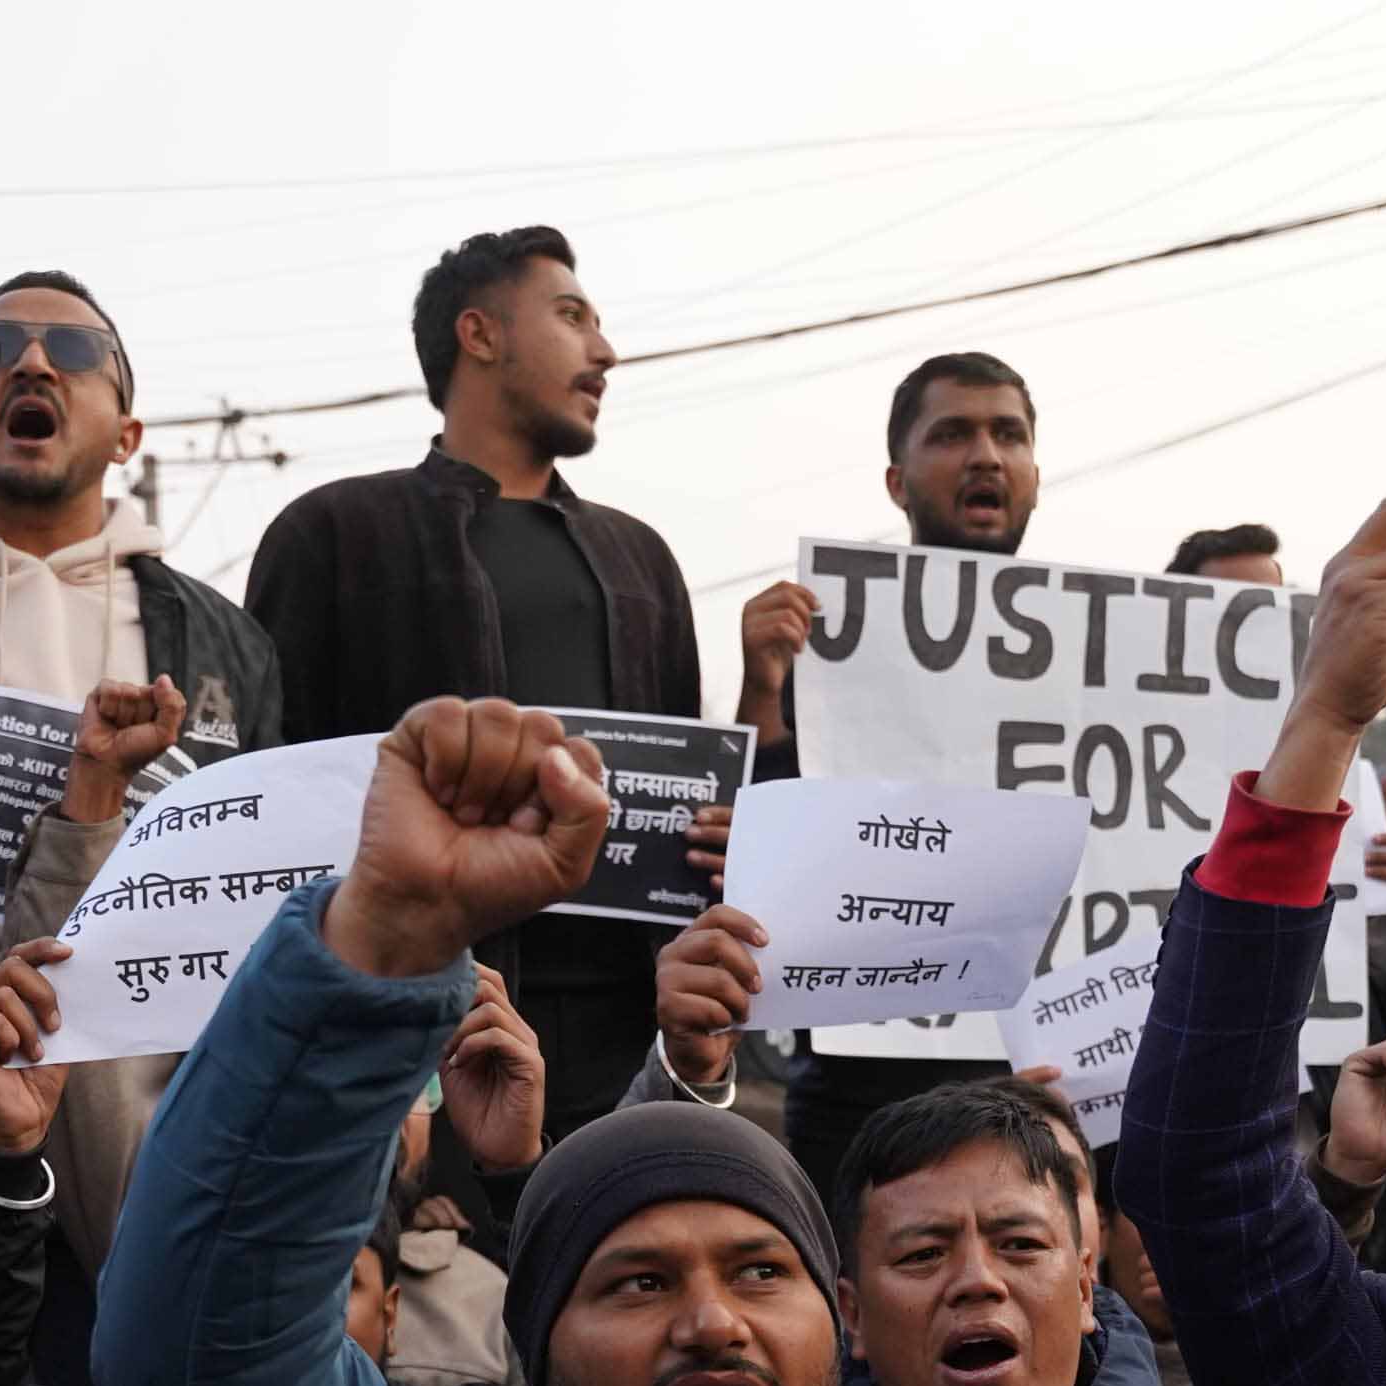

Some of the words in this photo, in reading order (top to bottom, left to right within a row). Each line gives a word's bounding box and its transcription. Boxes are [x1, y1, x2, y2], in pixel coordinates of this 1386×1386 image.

[41, 723, 68, 746] for
[997, 720, 1212, 831] FOR
[129, 794, 263, 847] अविलम्ब
[605, 842, 637, 865] गर
[837, 892, 955, 928] अन्याय
[115, 956, 171, 1003] सुरु
[179, 950, 229, 981] गर
[782, 963, 852, 992] सहन
[855, 958, 949, 989] जान्दैन
[1033, 977, 1108, 1026] नेपाली
